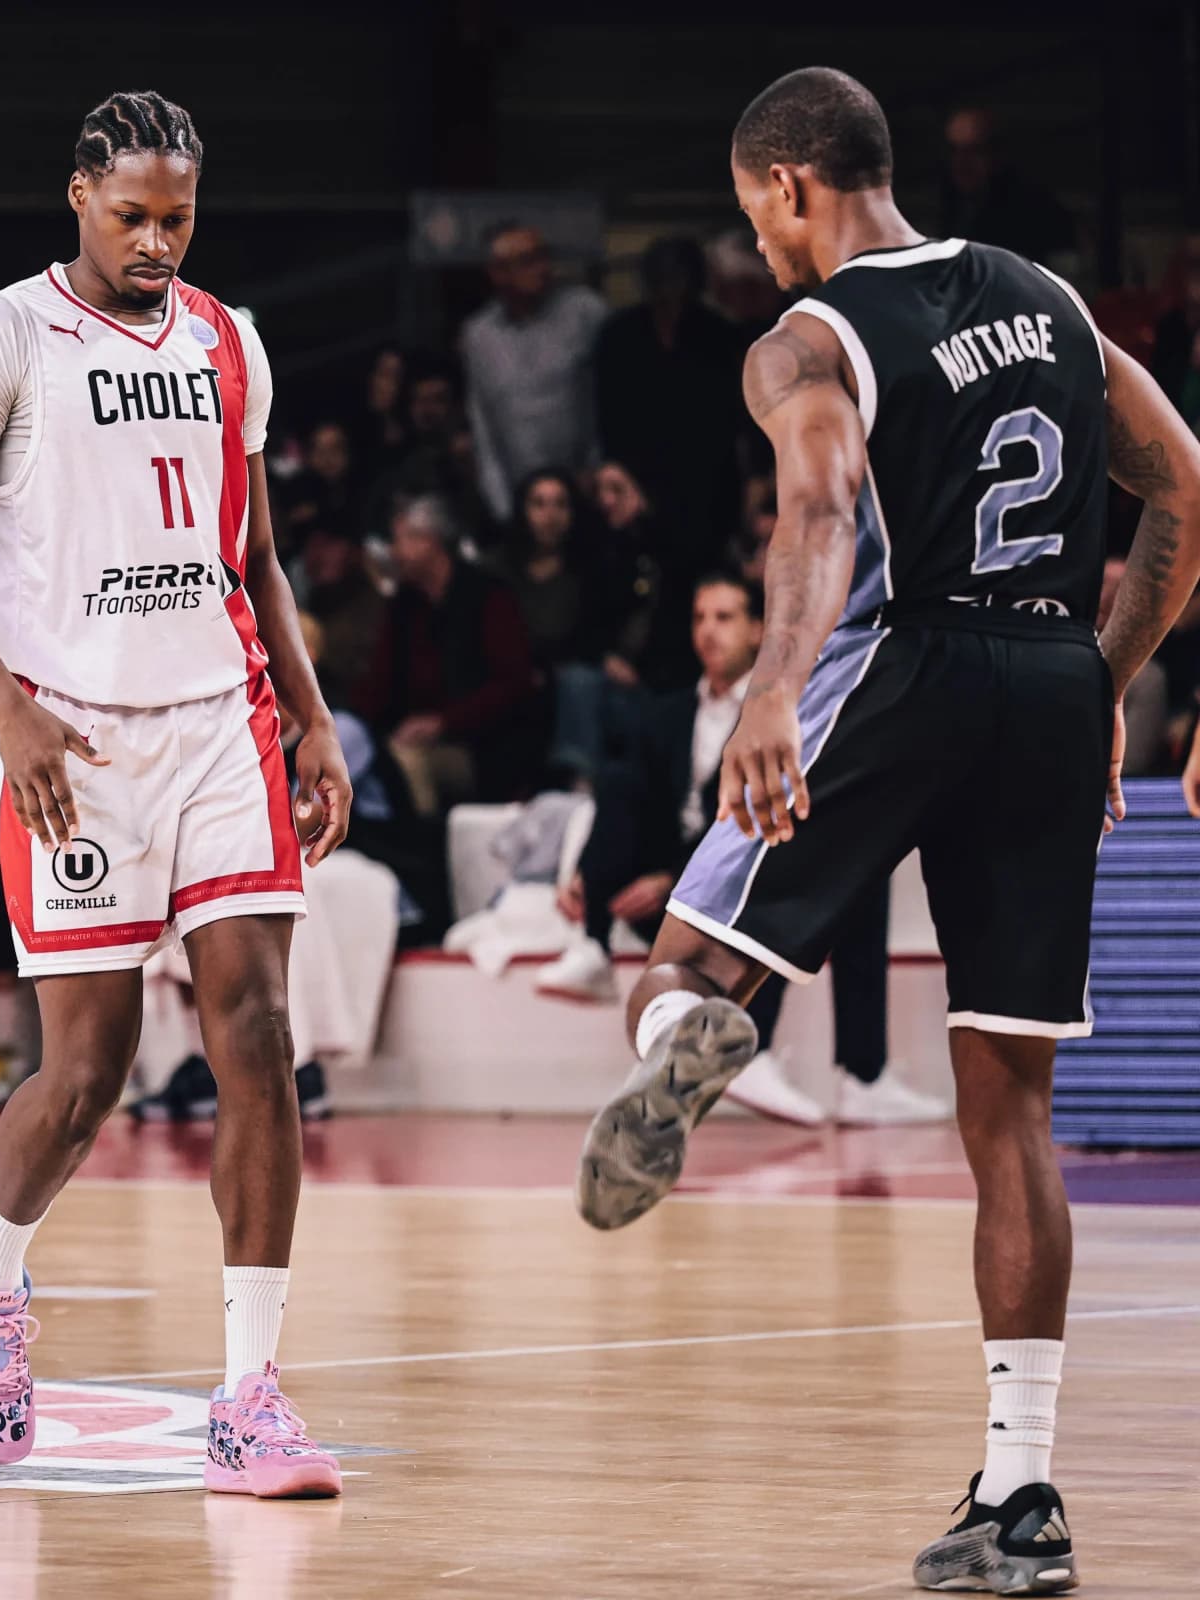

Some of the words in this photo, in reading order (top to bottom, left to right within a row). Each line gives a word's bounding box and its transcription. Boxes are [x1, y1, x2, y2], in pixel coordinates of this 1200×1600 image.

[930, 313, 1056, 394] NOTTAGE
[88, 368, 222, 426] CHOLET
[151, 457, 195, 529] 11
[970, 405, 1064, 575] 2
[82, 589, 202, 617] Transports
[64, 853, 94, 880] U
[45, 893, 117, 910] CHEMILLÉ
